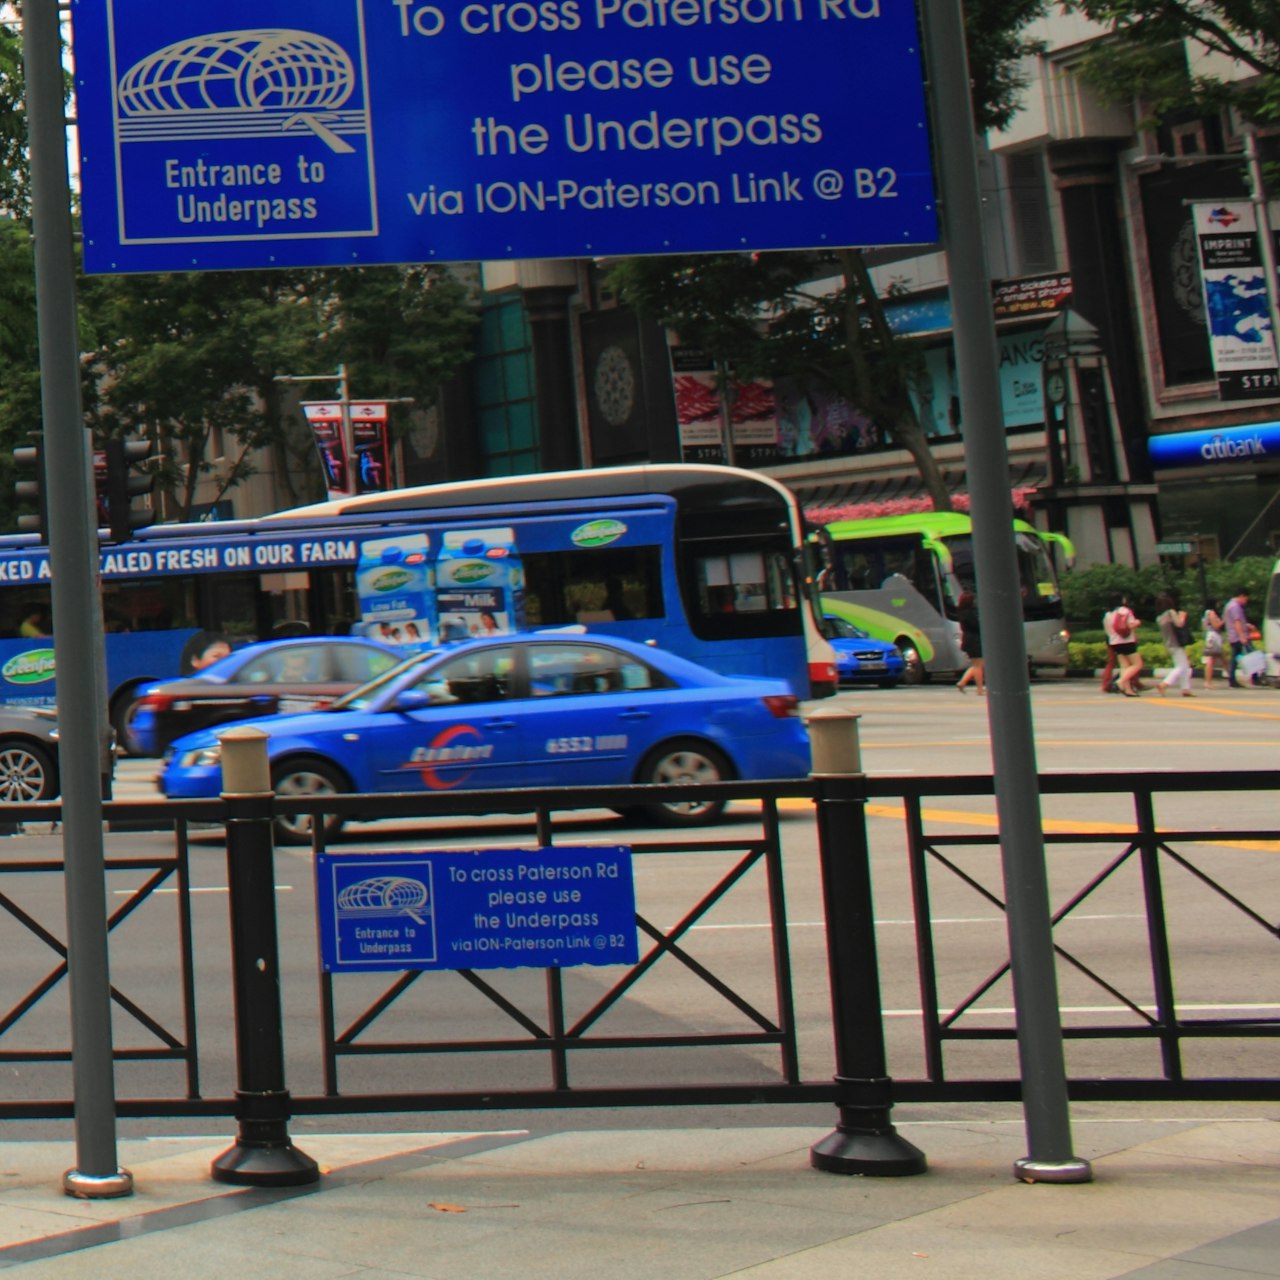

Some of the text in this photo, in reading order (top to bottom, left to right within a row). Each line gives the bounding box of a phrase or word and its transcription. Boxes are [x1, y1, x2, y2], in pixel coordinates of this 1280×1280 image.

[510, 53, 771, 101] please use
[472, 111, 822, 155] the Underpass
[166, 155, 325, 188] Entrance to
[408, 167, 898, 216] via ION-Paterson Link @ B2
[177, 193, 317, 228] Underpass
[1200, 434, 1266, 460] citibank
[156, 548, 218, 570] FRESH
[223, 545, 252, 567] ON
[254, 543, 294, 565] OUR
[301, 541, 356, 562] FARM
[464, 593, 496, 607] Milk
[449, 863, 618, 882] To cross Paterson Rd
[488, 888, 581, 907] please use
[474, 912, 599, 929] the Underpass
[355, 927, 416, 939] Entrance to
[451, 934, 625, 951] via ION-Paterson Link @ B2
[360, 941, 412, 955] Underpass
